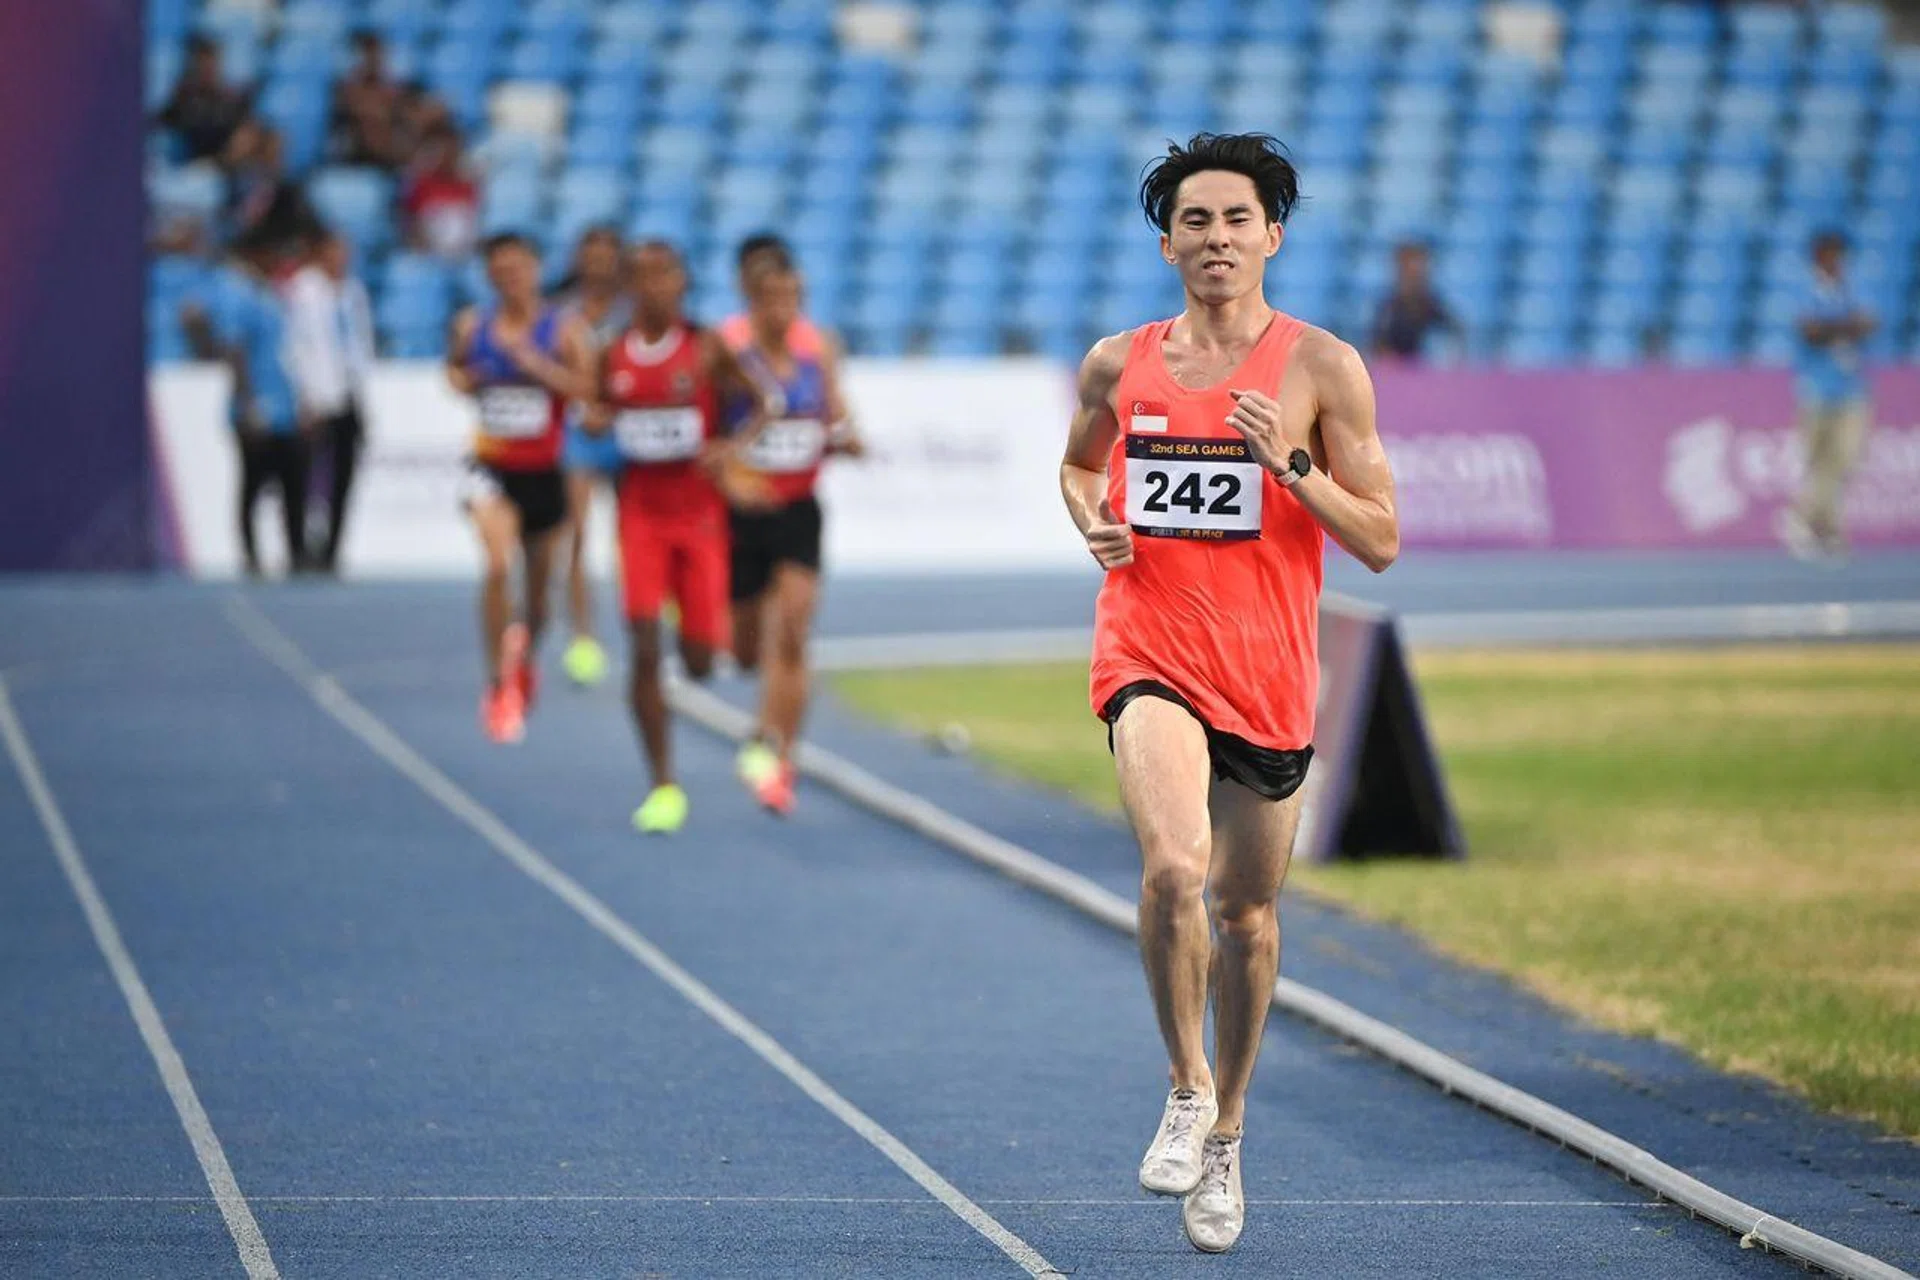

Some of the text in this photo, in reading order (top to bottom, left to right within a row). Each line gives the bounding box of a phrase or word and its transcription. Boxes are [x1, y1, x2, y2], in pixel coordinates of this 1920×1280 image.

[1150, 443, 1245, 456] 32nd SEA GAMES
[1143, 471, 1241, 515] 242
